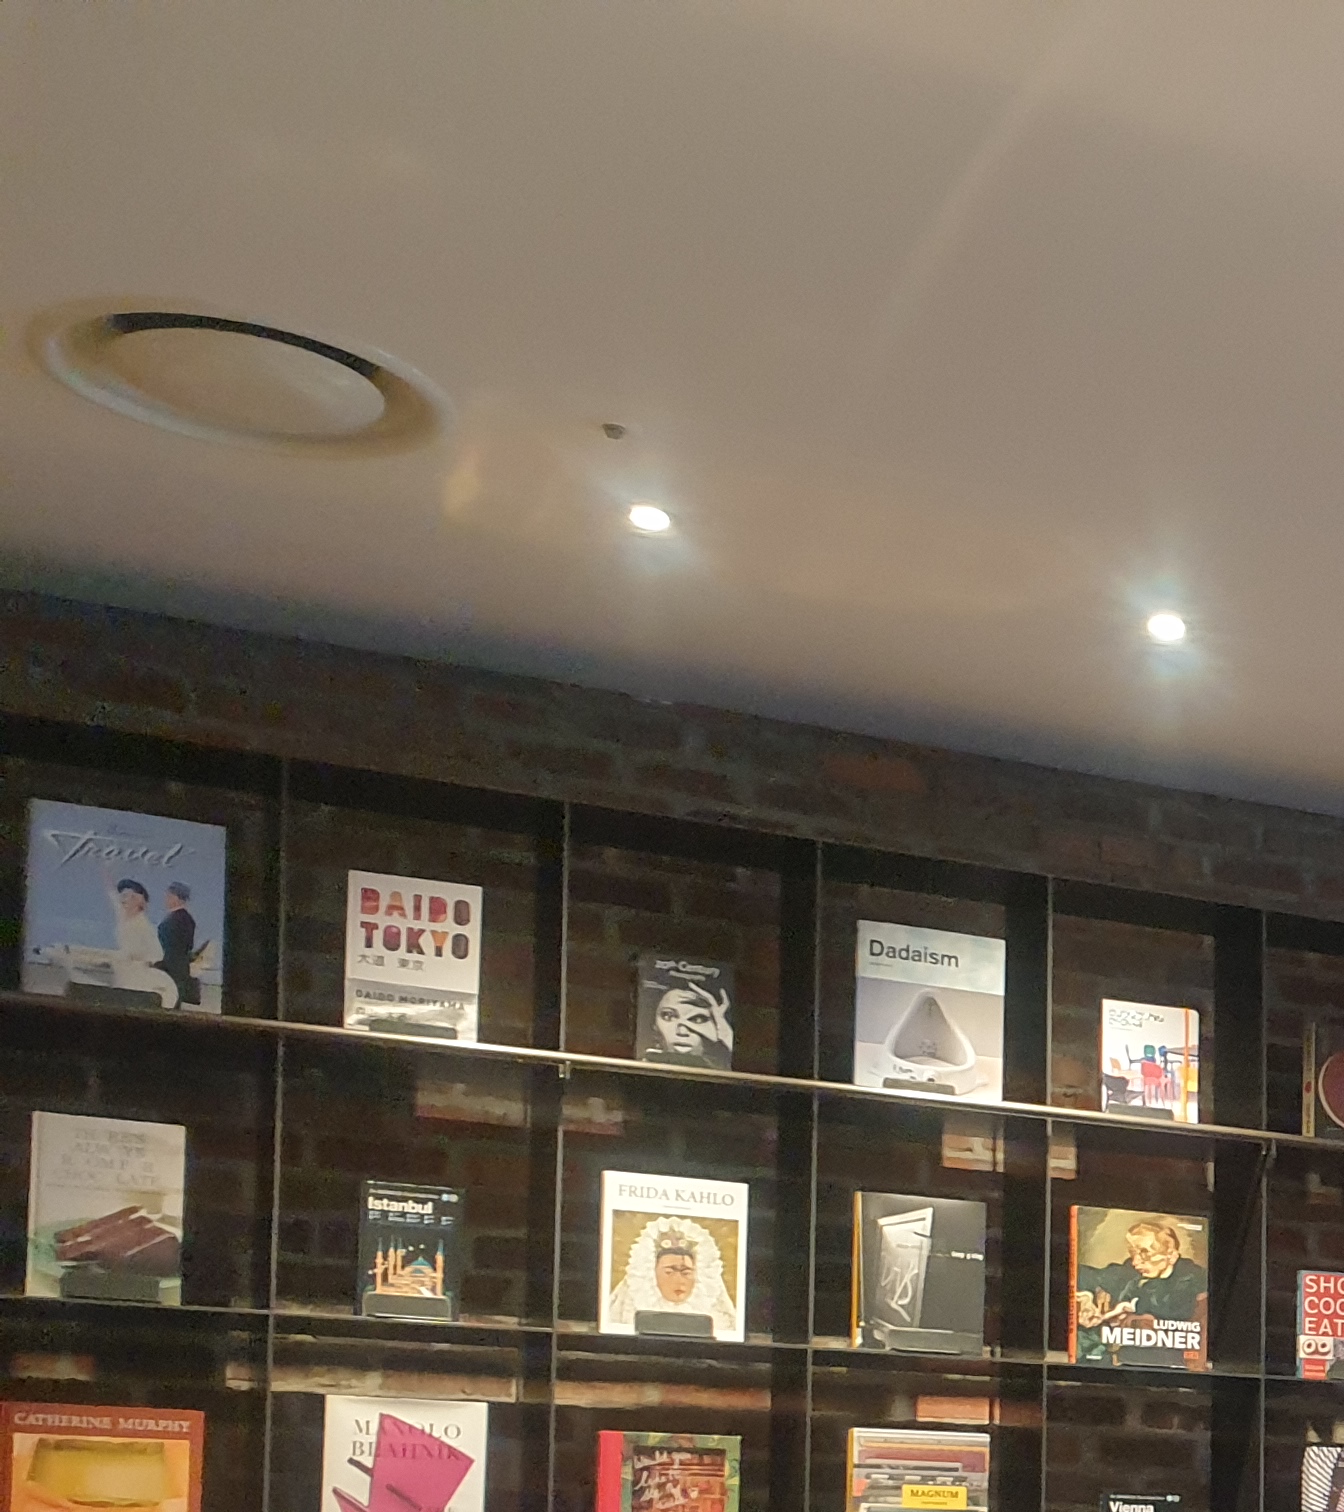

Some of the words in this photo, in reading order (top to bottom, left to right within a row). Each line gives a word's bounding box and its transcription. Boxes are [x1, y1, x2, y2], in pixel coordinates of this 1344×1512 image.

[361, 887, 471, 926] DAIDO
[360, 921, 471, 960] TOKYO
[869, 939, 960, 969] Dadaism
[367, 1196, 434, 1214] Istanbul
[618, 1184, 671, 1202] FRIDA
[675, 1188, 735, 1207] KAHLO
[1102, 1326, 1201, 1351] MEIDNER
[1153, 1319, 1201, 1335] LUDWIG
[14, 1412, 114, 1430] CATHERINE
[119, 1417, 191, 1434] MURPHY
[910, 1489, 959, 1499] MAGNUM
